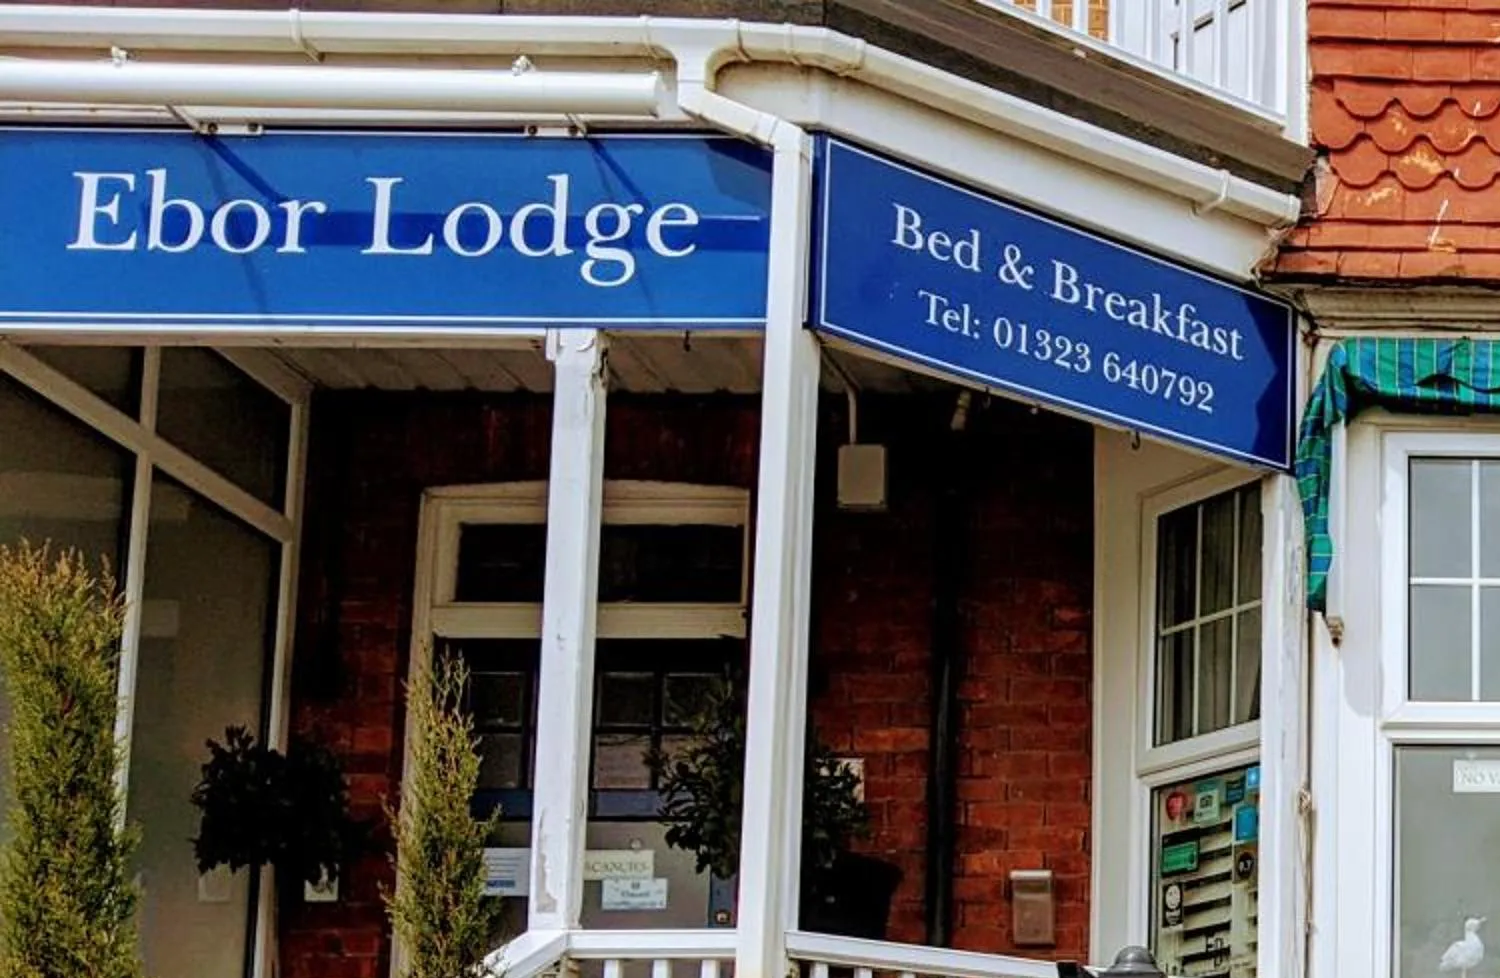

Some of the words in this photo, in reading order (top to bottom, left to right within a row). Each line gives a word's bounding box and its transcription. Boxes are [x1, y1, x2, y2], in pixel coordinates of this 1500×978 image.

[65, 168, 327, 253] Ebor
[361, 174, 700, 287] Lodge
[891, 203, 981, 272] Bed
[998, 244, 1035, 290] &
[1051, 259, 1245, 360] Breakfast
[918, 290, 980, 339] Tel:
[993, 317, 1092, 374] 01323
[1103, 353, 1214, 414] 640792
[1461, 769, 1485, 784] NO
